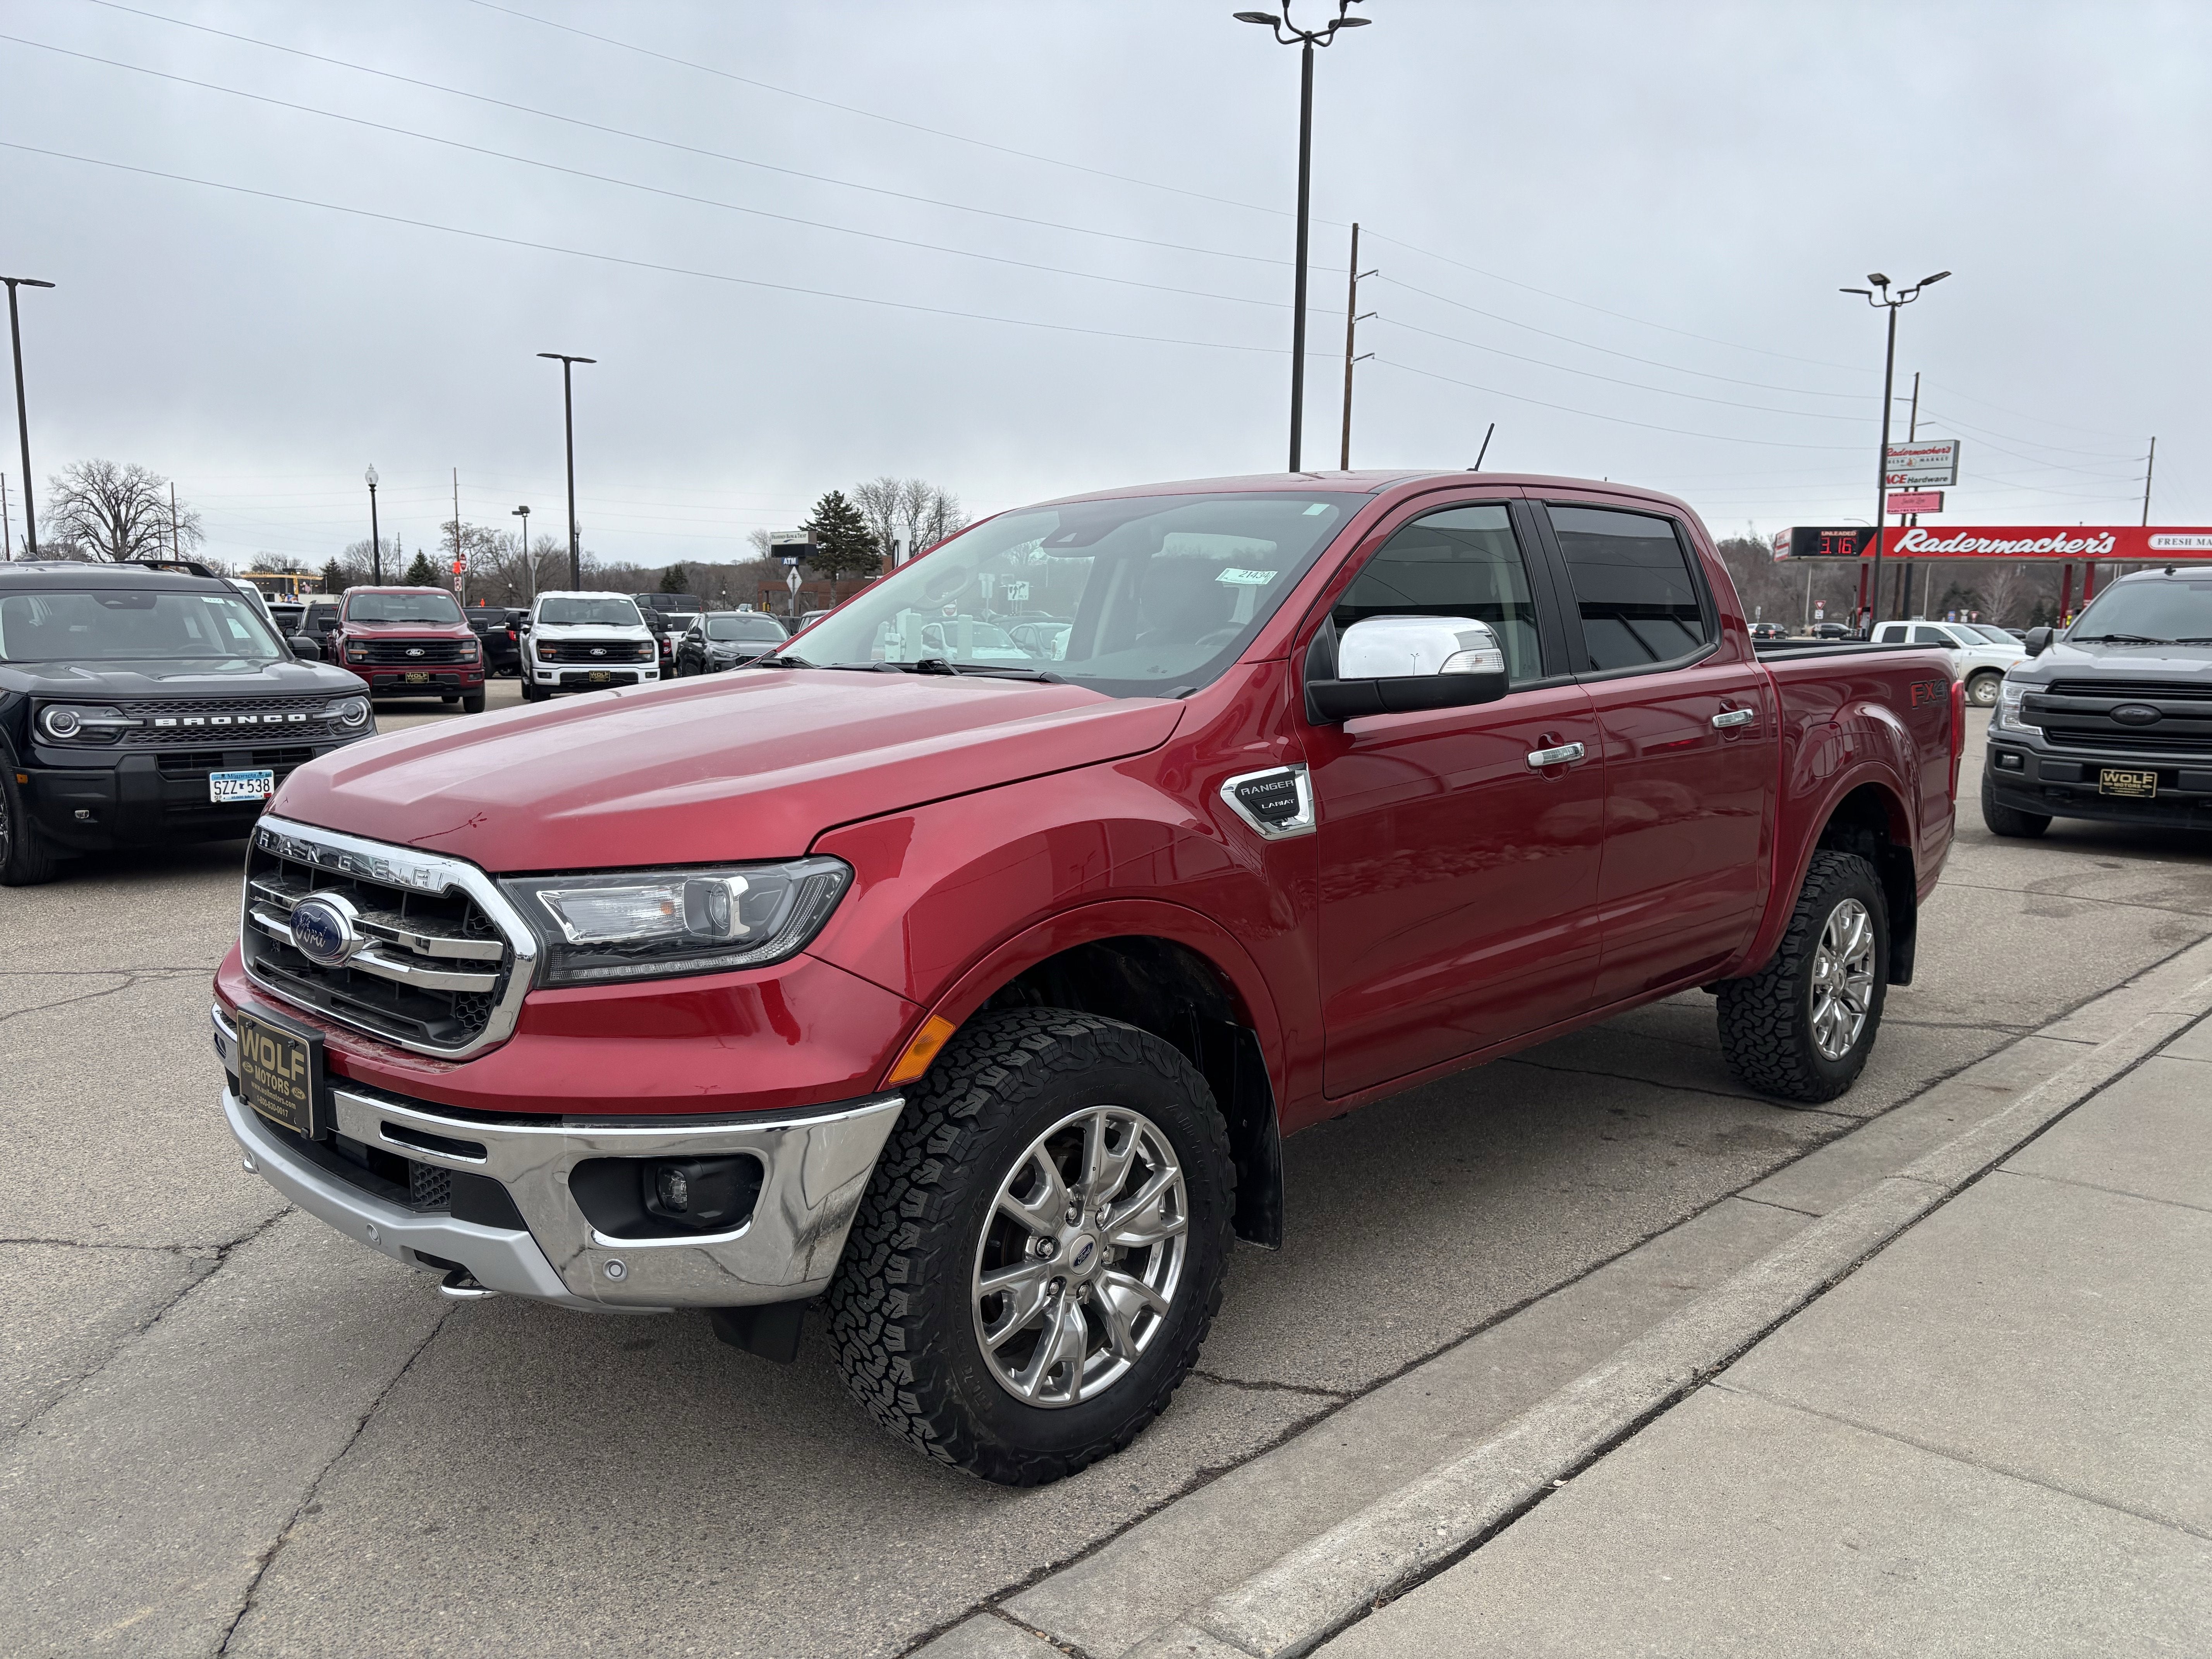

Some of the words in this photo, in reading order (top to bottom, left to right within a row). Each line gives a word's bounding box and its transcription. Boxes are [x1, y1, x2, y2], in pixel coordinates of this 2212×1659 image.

[1894, 529, 2116, 554] Radermacher's
[1910, 678, 1947, 709] FX4
[155, 714, 306, 726] BRONCO
[214, 780, 238, 795] SZZ
[247, 778, 270, 793] 538
[1240, 780, 1294, 796] RANGER
[2104, 773, 2153, 784] WOLF
[1262, 799, 1295, 809] LARIAT
[259, 830, 431, 888] RANGER
[295, 911, 328, 948] Ford
[240, 1025, 304, 1081] WOLF
[255, 1065, 290, 1096] MOTORS
[251, 1081, 296, 1110] www.wolfmotors.com
[257, 1095, 288, 1117] 1-800-830-0017
